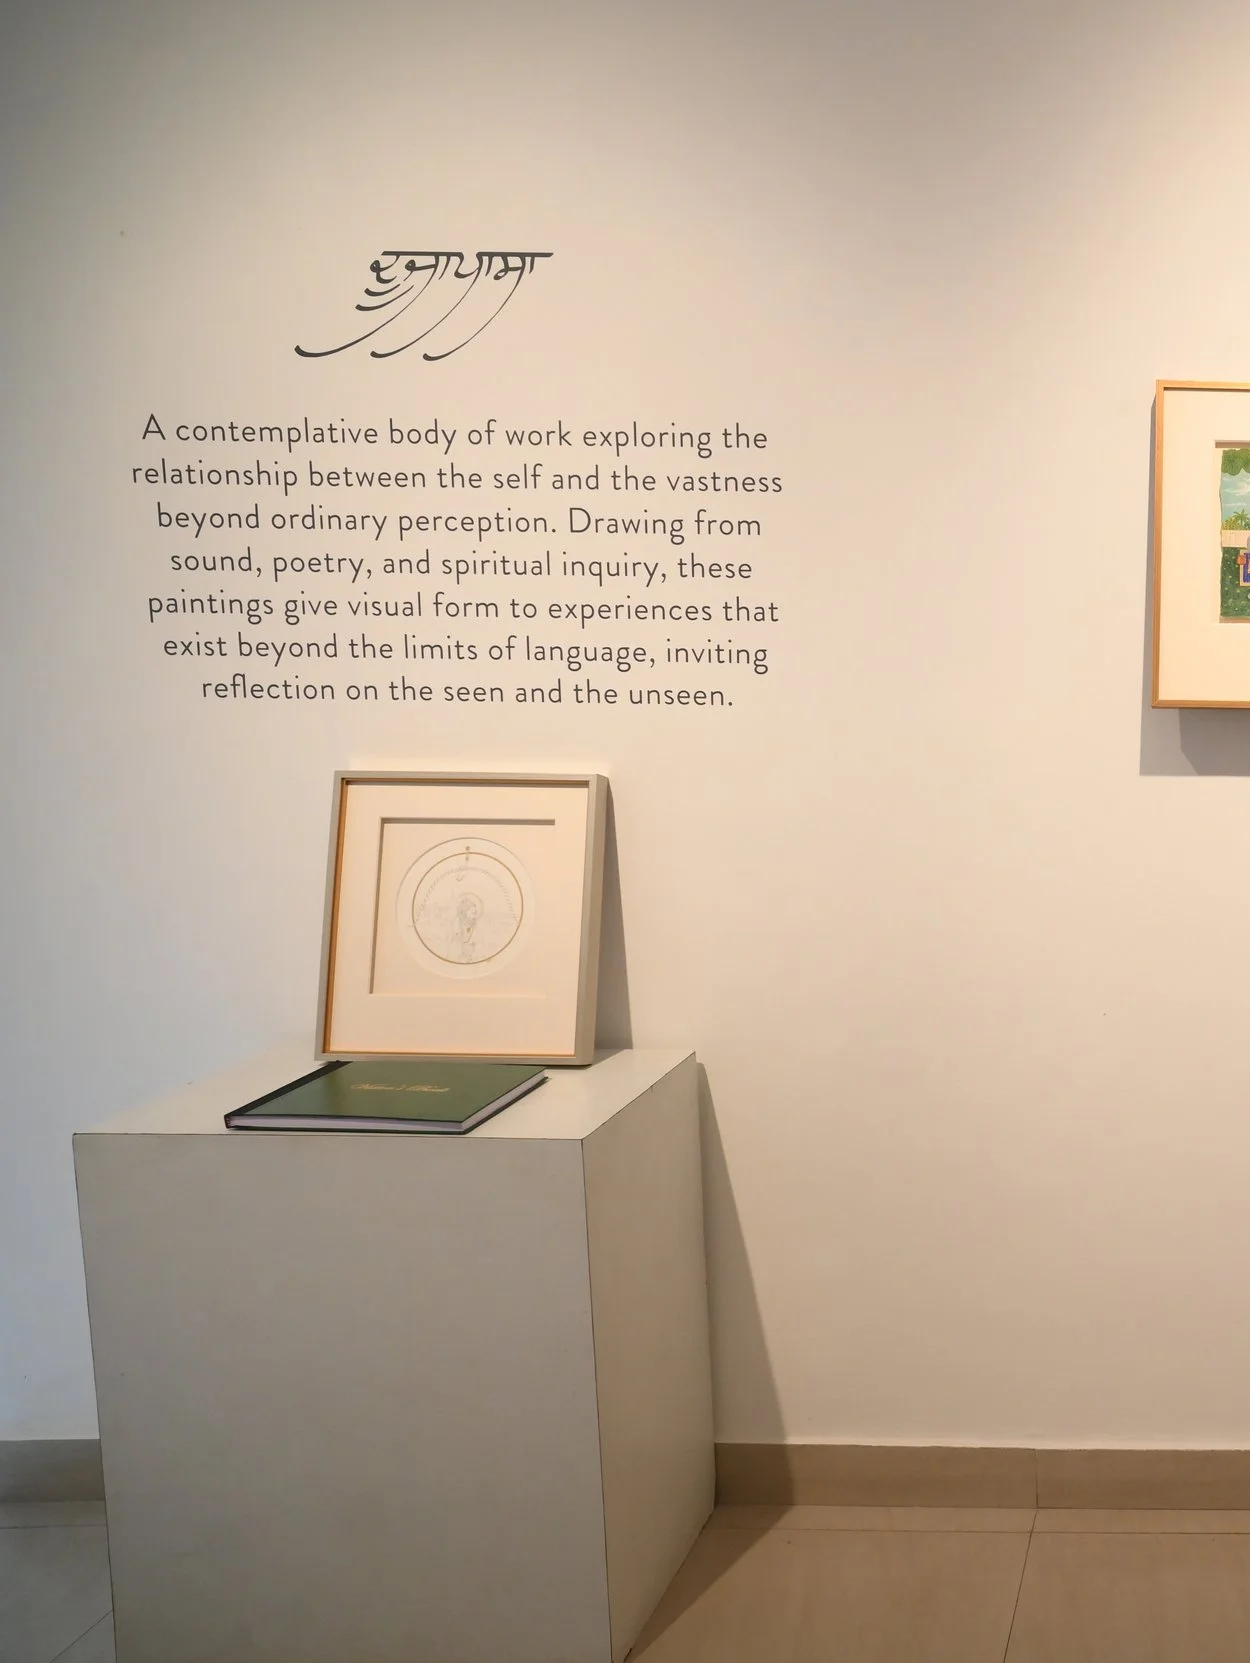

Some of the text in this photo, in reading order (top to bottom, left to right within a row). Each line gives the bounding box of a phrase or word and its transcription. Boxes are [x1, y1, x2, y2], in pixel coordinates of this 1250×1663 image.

[141, 412, 768, 460] A contemplative body of work exploring the
[132, 457, 783, 497] relationship between the self and the vastness
[156, 500, 761, 546] beyond ordinary perception. Drawing from
[170, 545, 753, 588] sound, poetry, and spiritual inquiry, these
[148, 588, 780, 630] paintings give visual form to experiences that
[163, 630, 769, 676] exist beyond the limits of language, inviting
[202, 672, 733, 707] reflection on the seen and the unseen.
